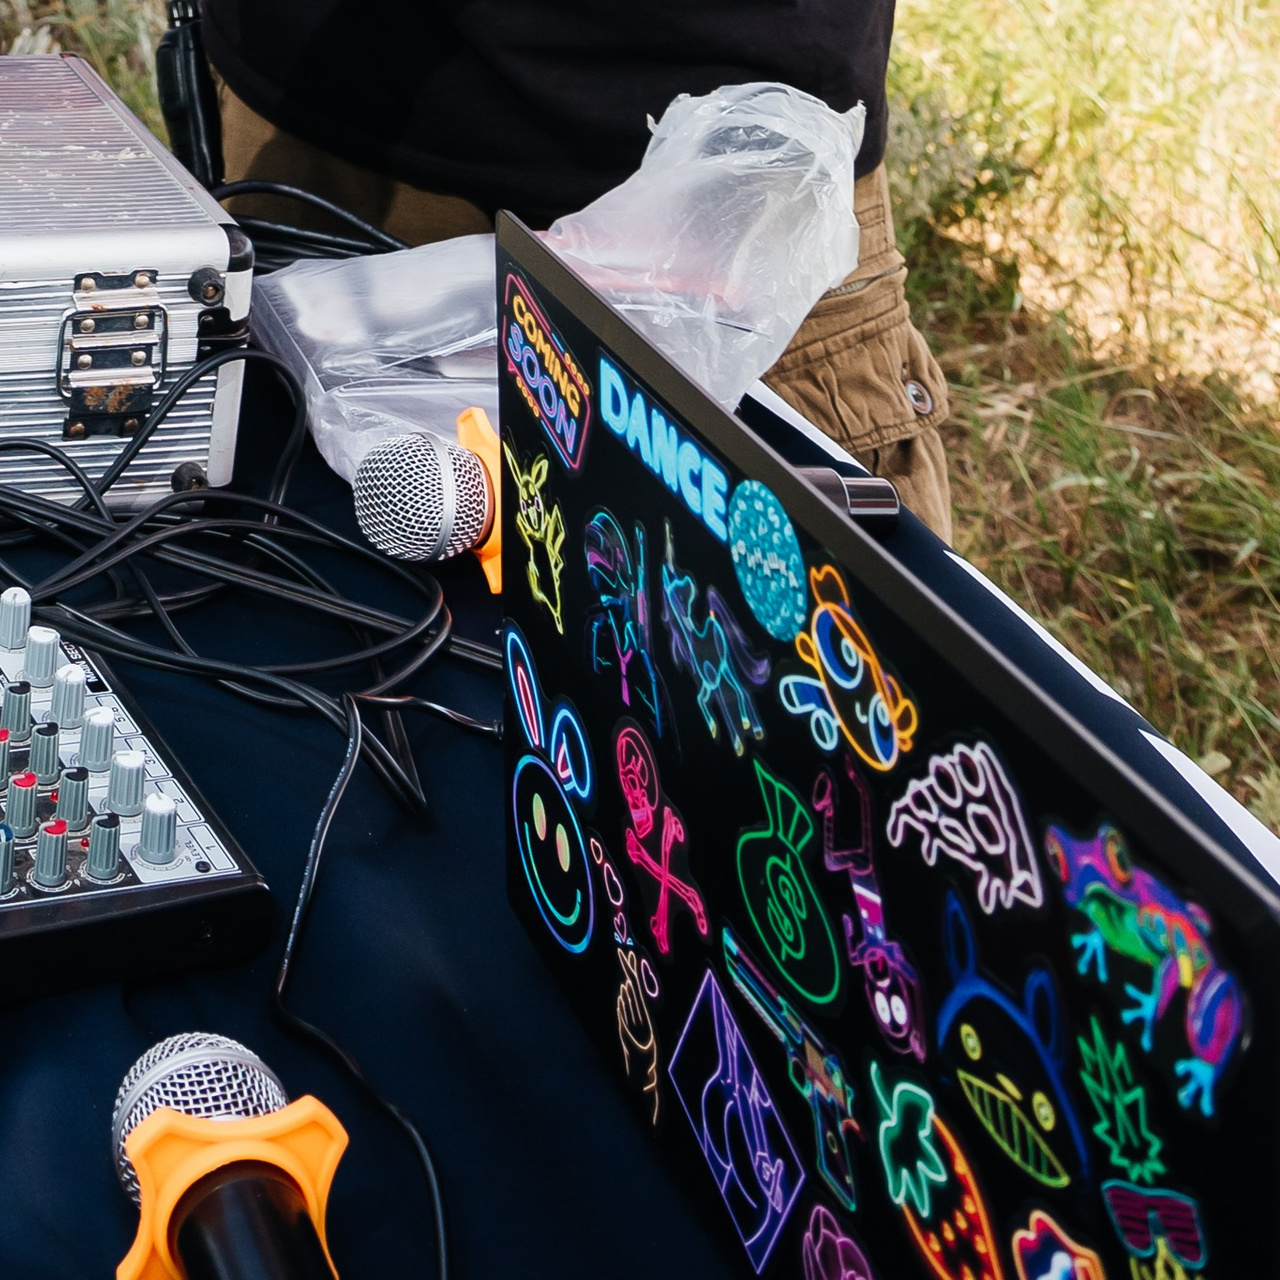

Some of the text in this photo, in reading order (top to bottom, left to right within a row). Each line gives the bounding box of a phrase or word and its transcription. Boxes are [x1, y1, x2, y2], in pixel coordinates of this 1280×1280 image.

[508, 322, 577, 455] SOON
[513, 294, 581, 418] COMING
[599, 356, 730, 543] DANCE
